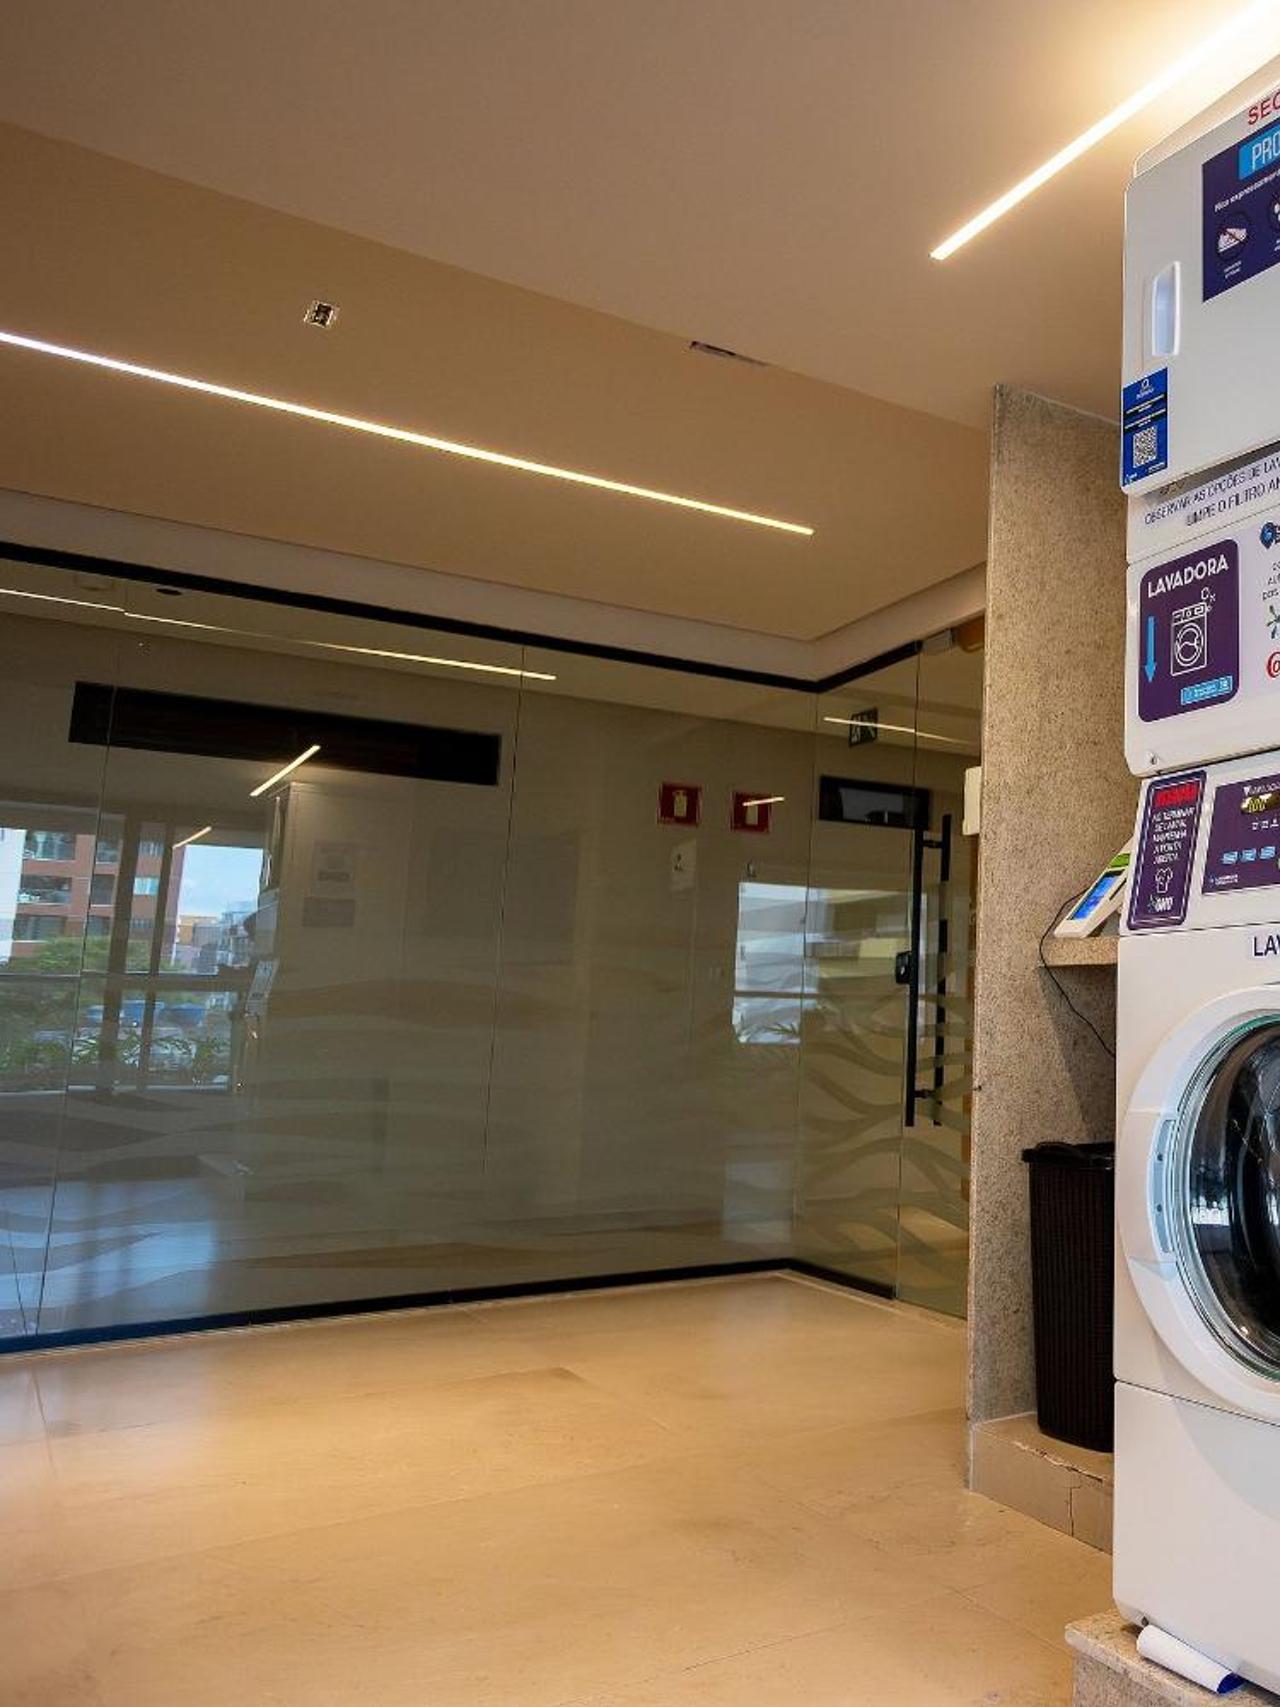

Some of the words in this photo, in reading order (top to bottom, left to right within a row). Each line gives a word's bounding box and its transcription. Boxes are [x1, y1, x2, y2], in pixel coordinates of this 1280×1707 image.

[1247, 465, 1261, 480] DE
[1187, 504, 1216, 527] LIMPE
[1218, 499, 1227, 514] O
[1228, 482, 1266, 510] FILTRO
[1147, 553, 1230, 599] LAVADORA
